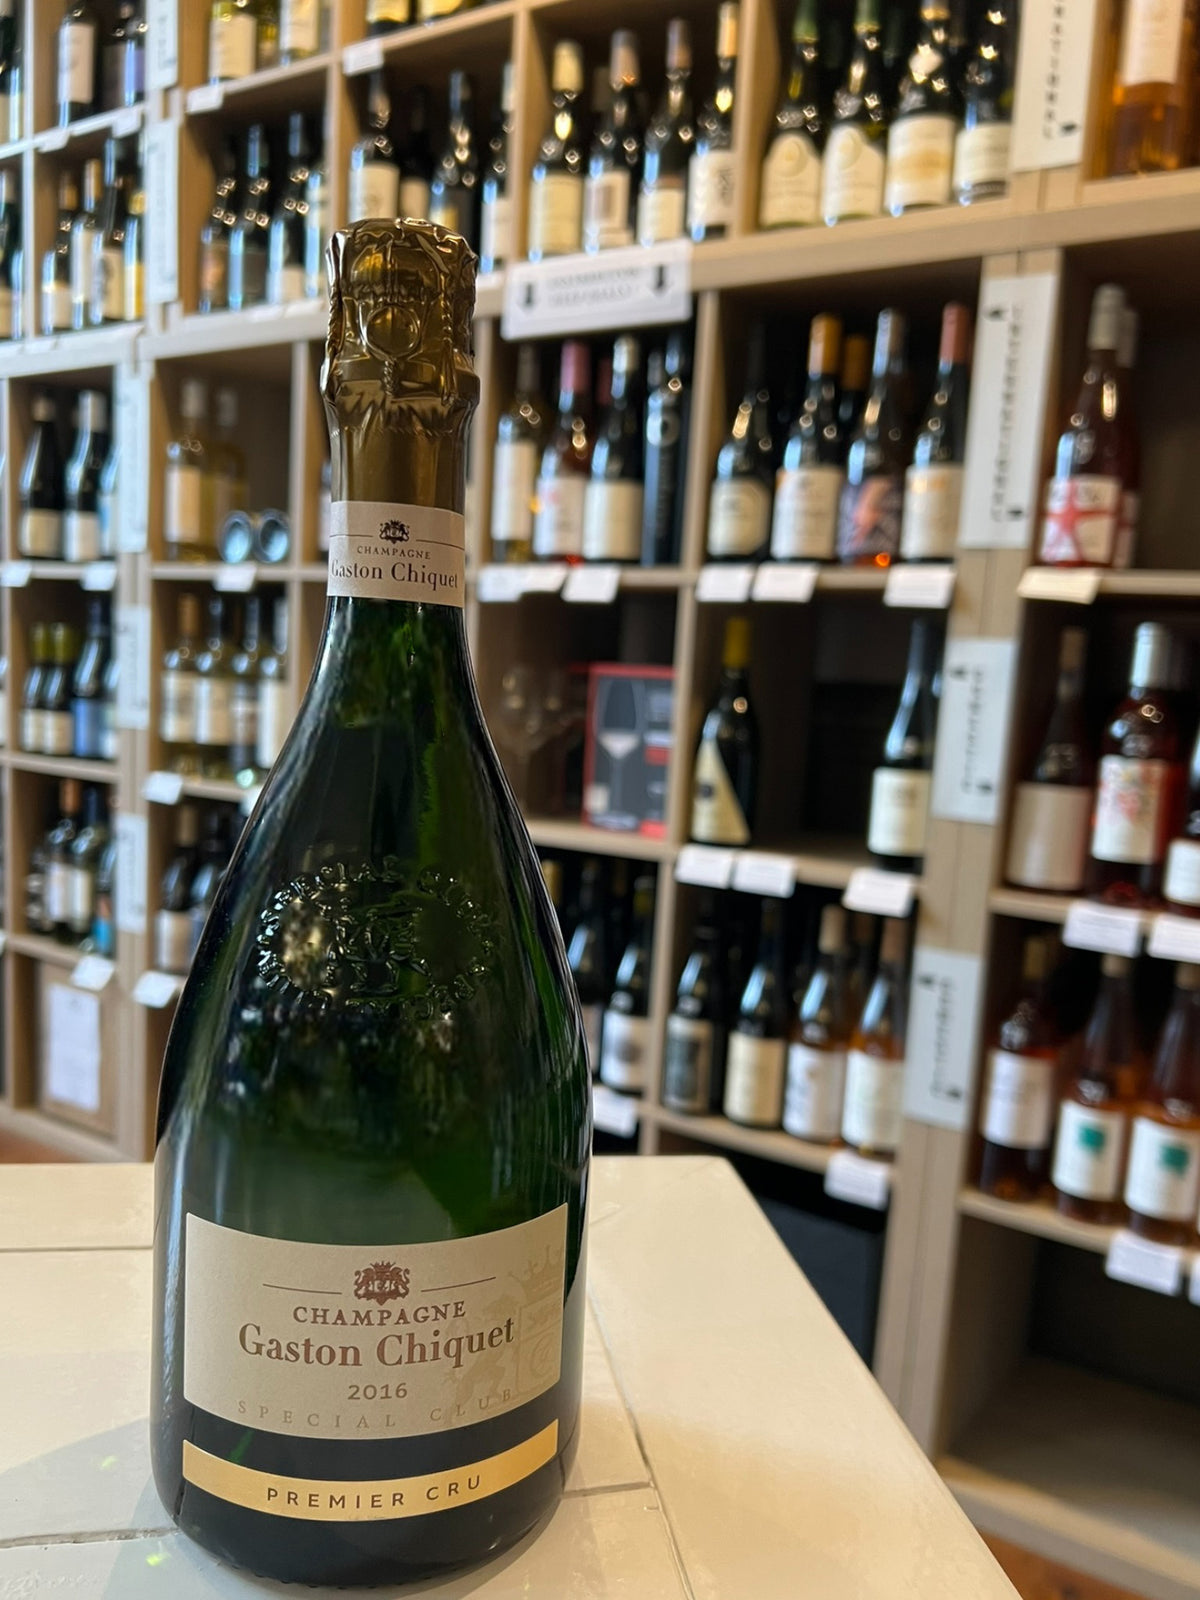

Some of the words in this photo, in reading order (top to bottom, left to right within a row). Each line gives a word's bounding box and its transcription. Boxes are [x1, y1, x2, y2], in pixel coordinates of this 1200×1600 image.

[357, 546, 431, 560] CHAMPAGNE
[331, 560, 383, 580] Gaston
[391, 562, 458, 591] Chiquet
[293, 1301, 466, 1326] CHAMPAGNE
[239, 1323, 363, 1367] Gaston
[376, 1318, 514, 1369] Chiquet
[348, 1383, 408, 1400] 2016
[238, 1400, 396, 1429] SPECIAL
[430, 1388, 511, 1421] CLUB
[267, 1487, 404, 1509] PREMIER
[426, 1475, 480, 1500] CRU
